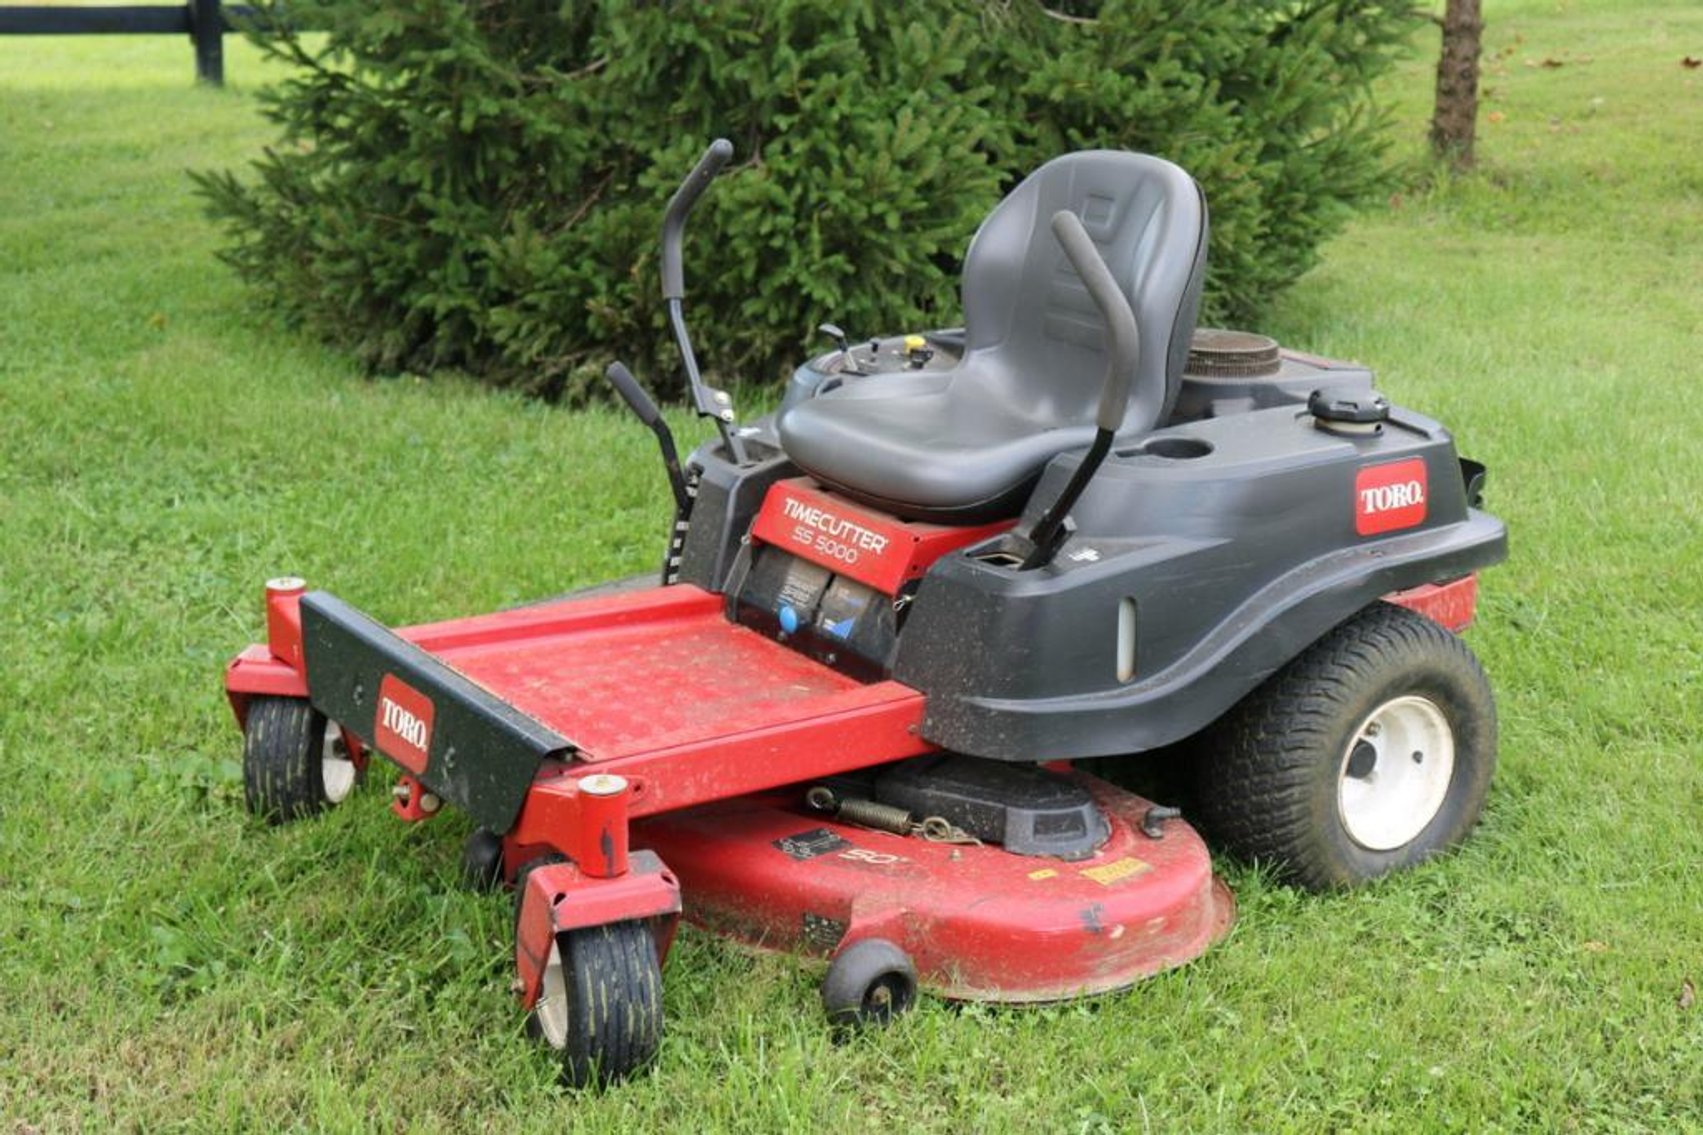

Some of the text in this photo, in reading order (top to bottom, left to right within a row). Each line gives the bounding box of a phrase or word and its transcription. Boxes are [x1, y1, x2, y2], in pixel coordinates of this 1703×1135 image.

[784, 497, 887, 554] TIMECUTTER
[792, 525, 857, 564] SS 5000
